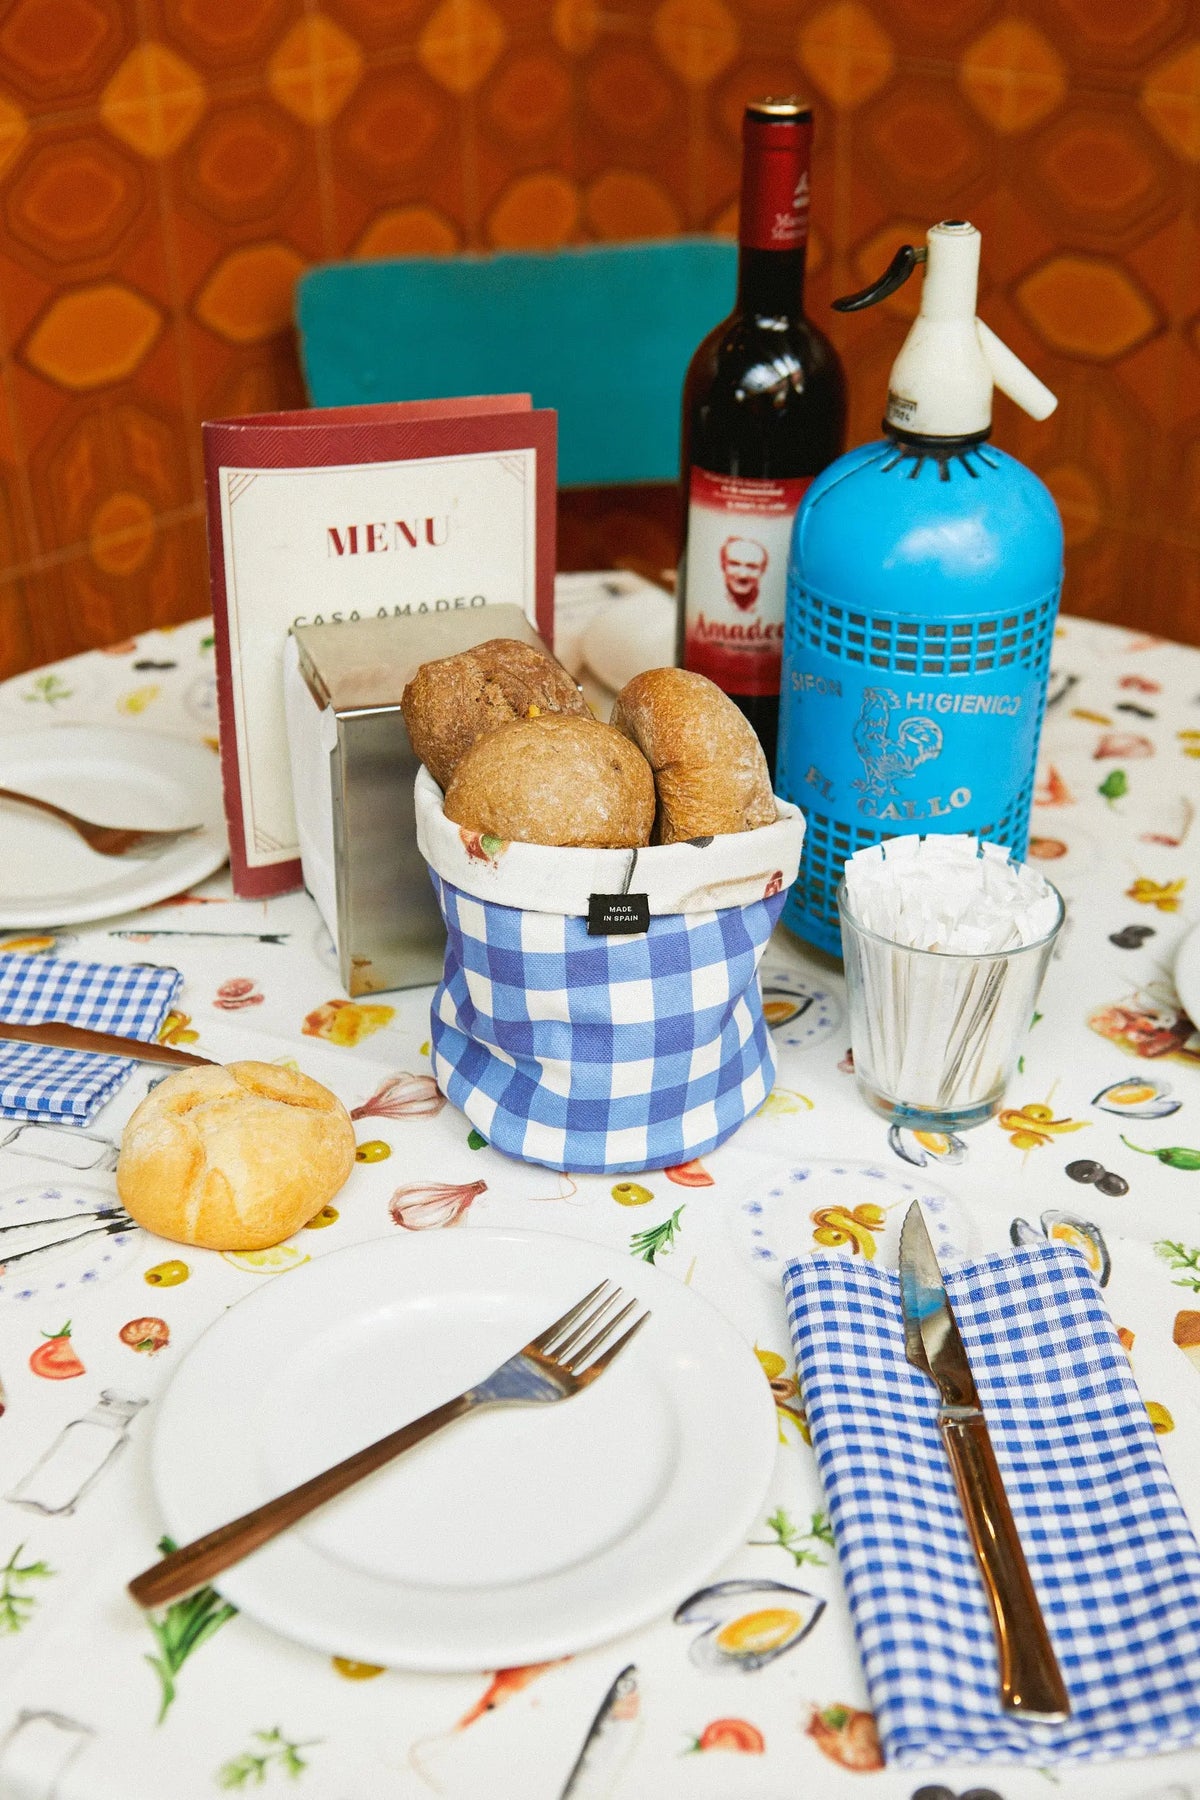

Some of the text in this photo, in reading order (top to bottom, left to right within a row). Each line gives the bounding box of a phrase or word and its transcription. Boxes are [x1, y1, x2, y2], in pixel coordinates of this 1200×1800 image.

[327, 514, 450, 558] MENU
[293, 594, 487, 629] CASA AMADEO
[790, 671, 1022, 718] SIFON HIGIENICO
[856, 786, 973, 822] GALLO
